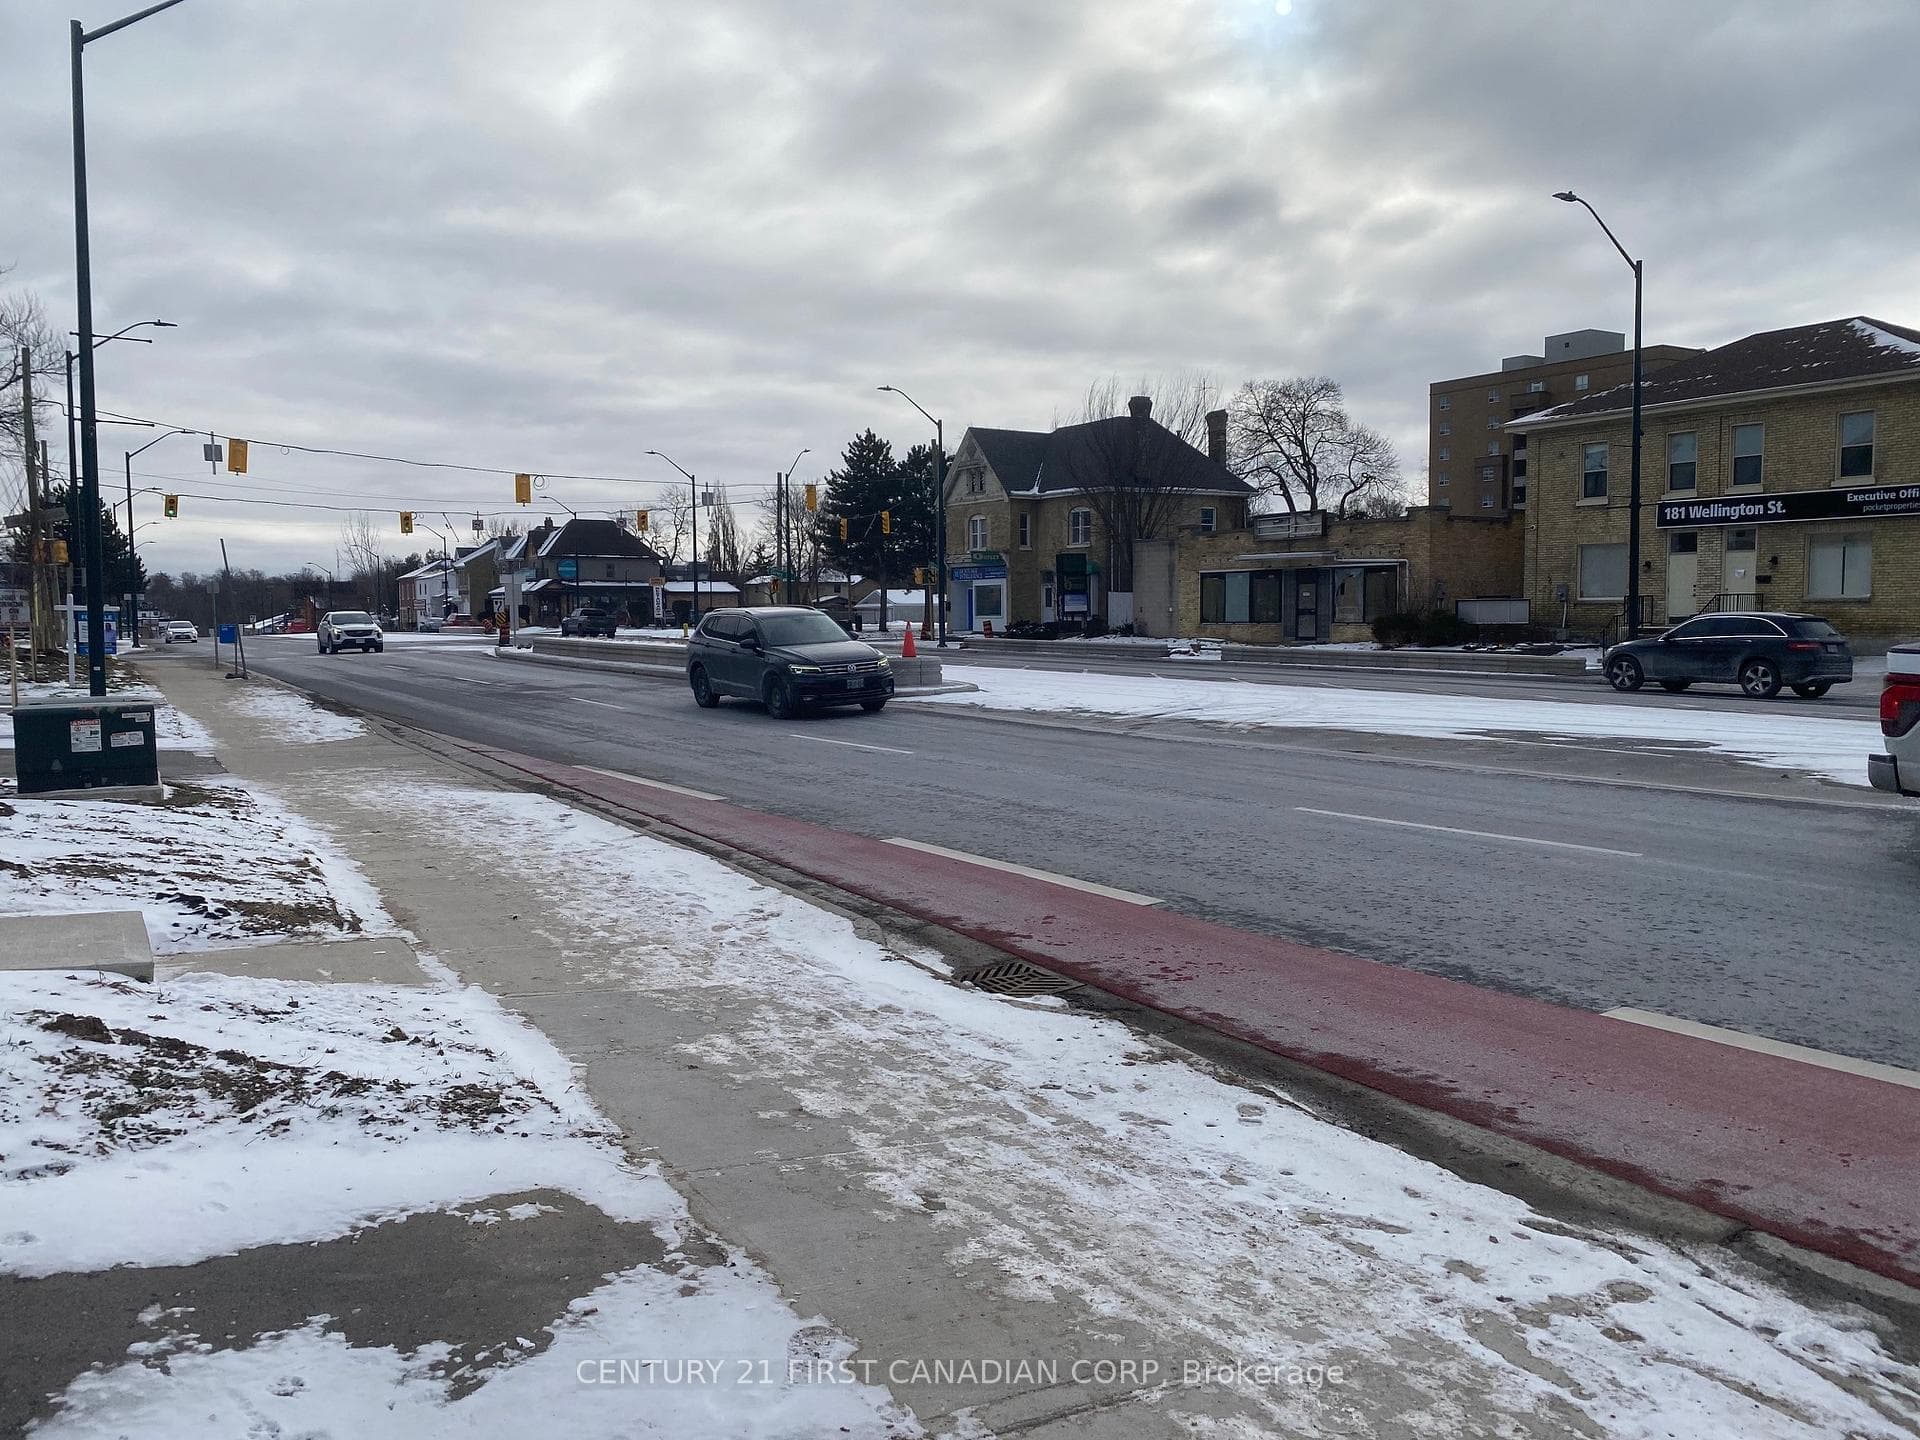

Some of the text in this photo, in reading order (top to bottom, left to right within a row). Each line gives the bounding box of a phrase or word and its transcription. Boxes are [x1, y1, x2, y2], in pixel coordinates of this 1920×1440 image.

[1847, 490, 1896, 502] Executive
[1664, 500, 1786, 520] 181 Wellington St.
